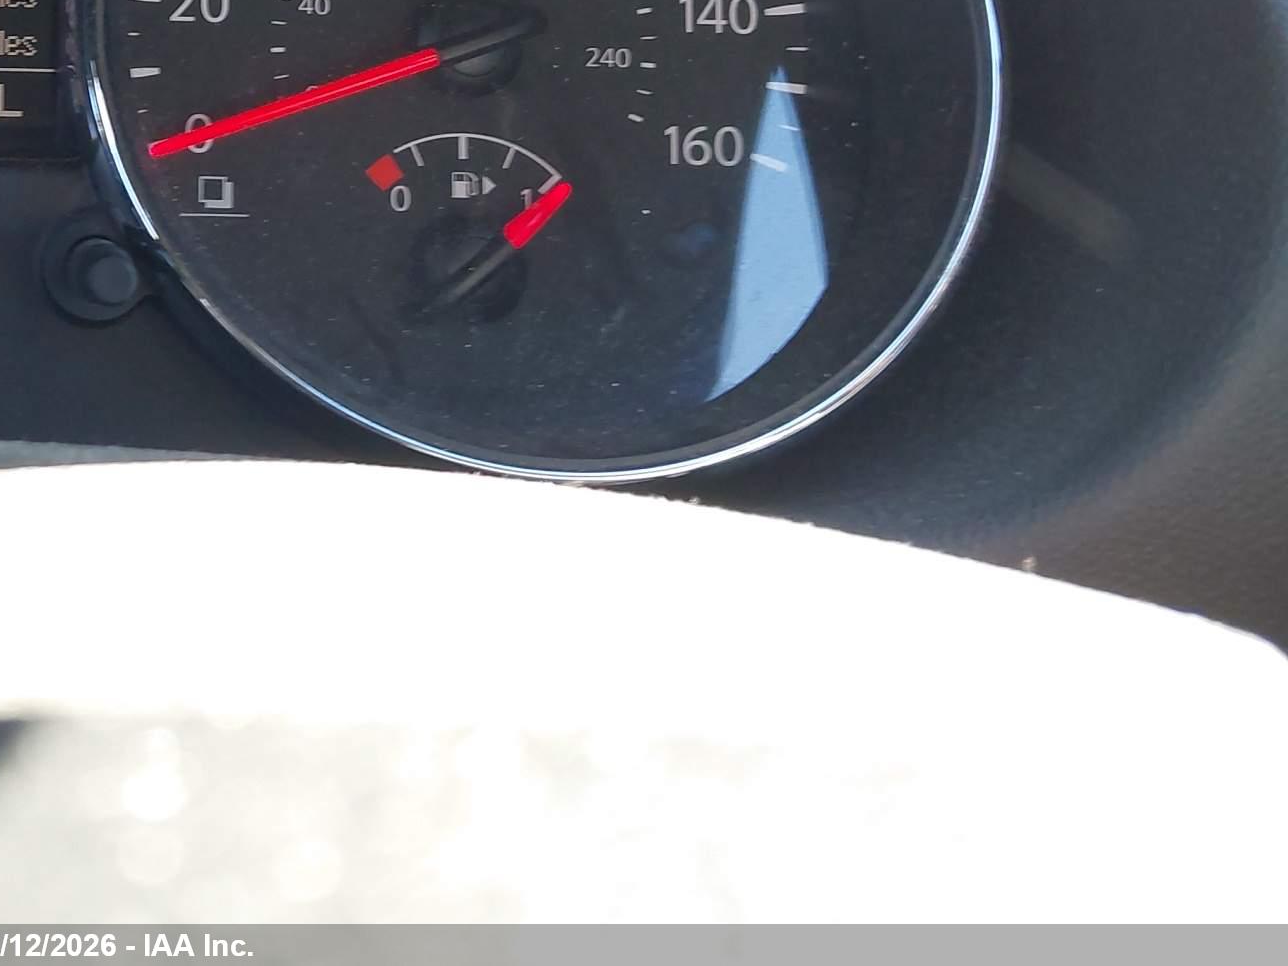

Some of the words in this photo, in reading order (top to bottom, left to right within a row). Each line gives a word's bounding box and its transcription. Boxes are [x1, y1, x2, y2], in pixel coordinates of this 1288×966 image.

[585, 47, 631, 68] 240
[184, 113, 214, 154] 0
[663, 125, 744, 167] 160
[390, 185, 412, 212] 0
